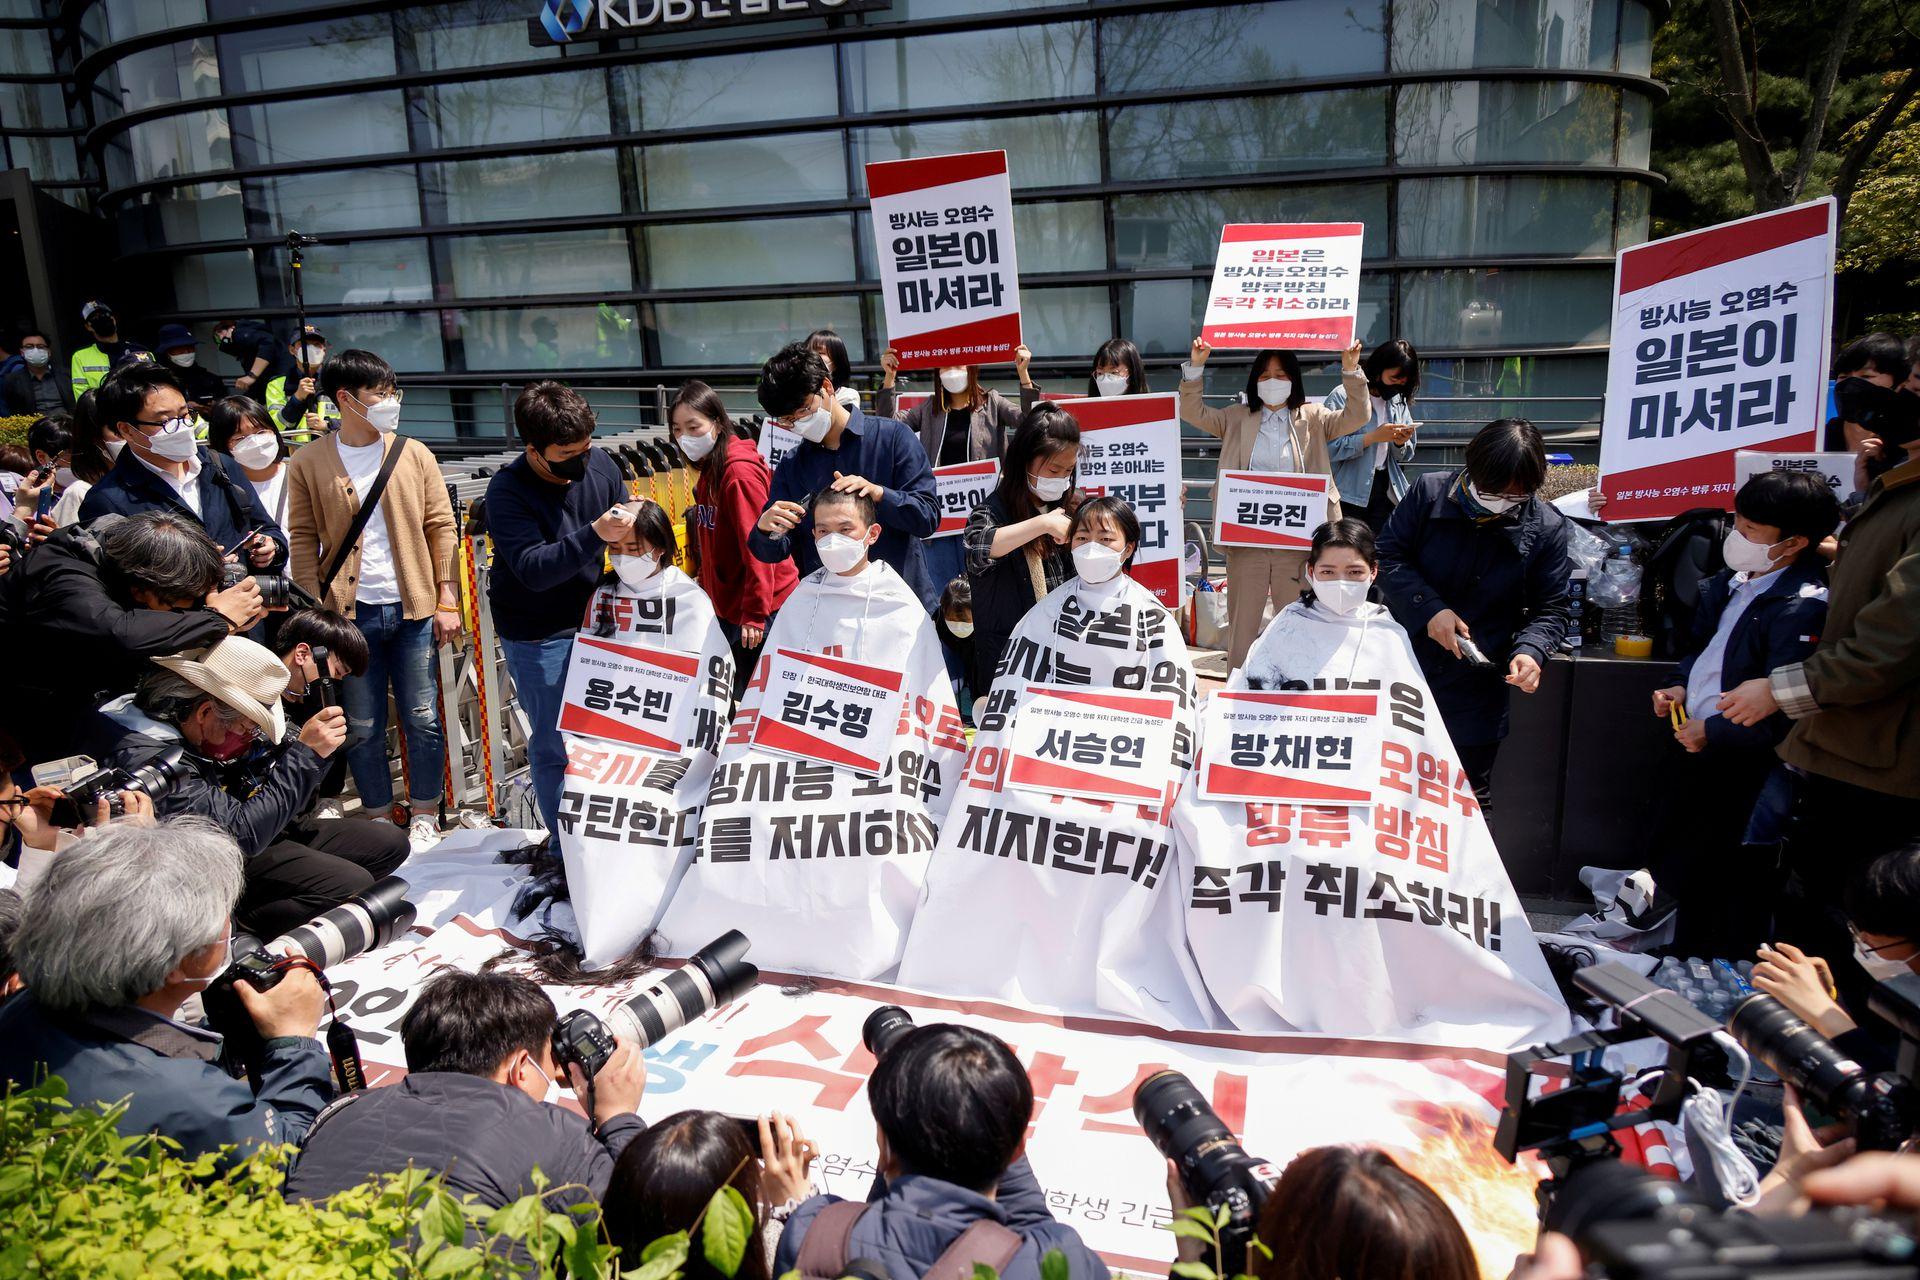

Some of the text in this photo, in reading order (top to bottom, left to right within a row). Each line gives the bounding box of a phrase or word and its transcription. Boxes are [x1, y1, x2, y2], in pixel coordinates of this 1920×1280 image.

[889, 205, 994, 230] 방사능 오염수
[892, 229, 999, 272] 일본이
[1252, 249, 1325, 263] 일본은
[897, 272, 1004, 314] 마셔라
[1213, 297, 1350, 310] 즉각 취소하라
[1640, 281, 1799, 330] 방사능 오염수
[1635, 312, 1799, 386] 일본이
[1627, 374, 1797, 441] 마셔라
[1077, 442, 1149, 458] 사능 오염수
[1080, 460, 1165, 476] 망언 쏟아내는
[1772, 459, 1818, 473] 일본은
[1616, 490, 1633, 501] 일본
[1634, 488, 1660, 499] 방사능
[1662, 486, 1689, 498] 오염수
[1691, 484, 1710, 496] 방류
[1712, 483, 1731, 494] 저지
[1237, 502, 1307, 527] 김유진
[584, 677, 673, 723] 용수빈
[782, 670, 888, 700] 단장 한국대학생진보연합 대표
[781, 691, 873, 739] 김수형
[1035, 728, 1146, 769] 서승연
[1231, 733, 1353, 770] 방채현
[707, 761, 834, 808] 방사능
[956, 804, 1170, 890] 지지한다!
[1246, 802, 1449, 874] 방류 방침
[1190, 861, 1502, 952] 즉각 취소하라!
[809, 1154, 877, 1180] 염수
[1045, 1188, 1110, 1221] 학생
